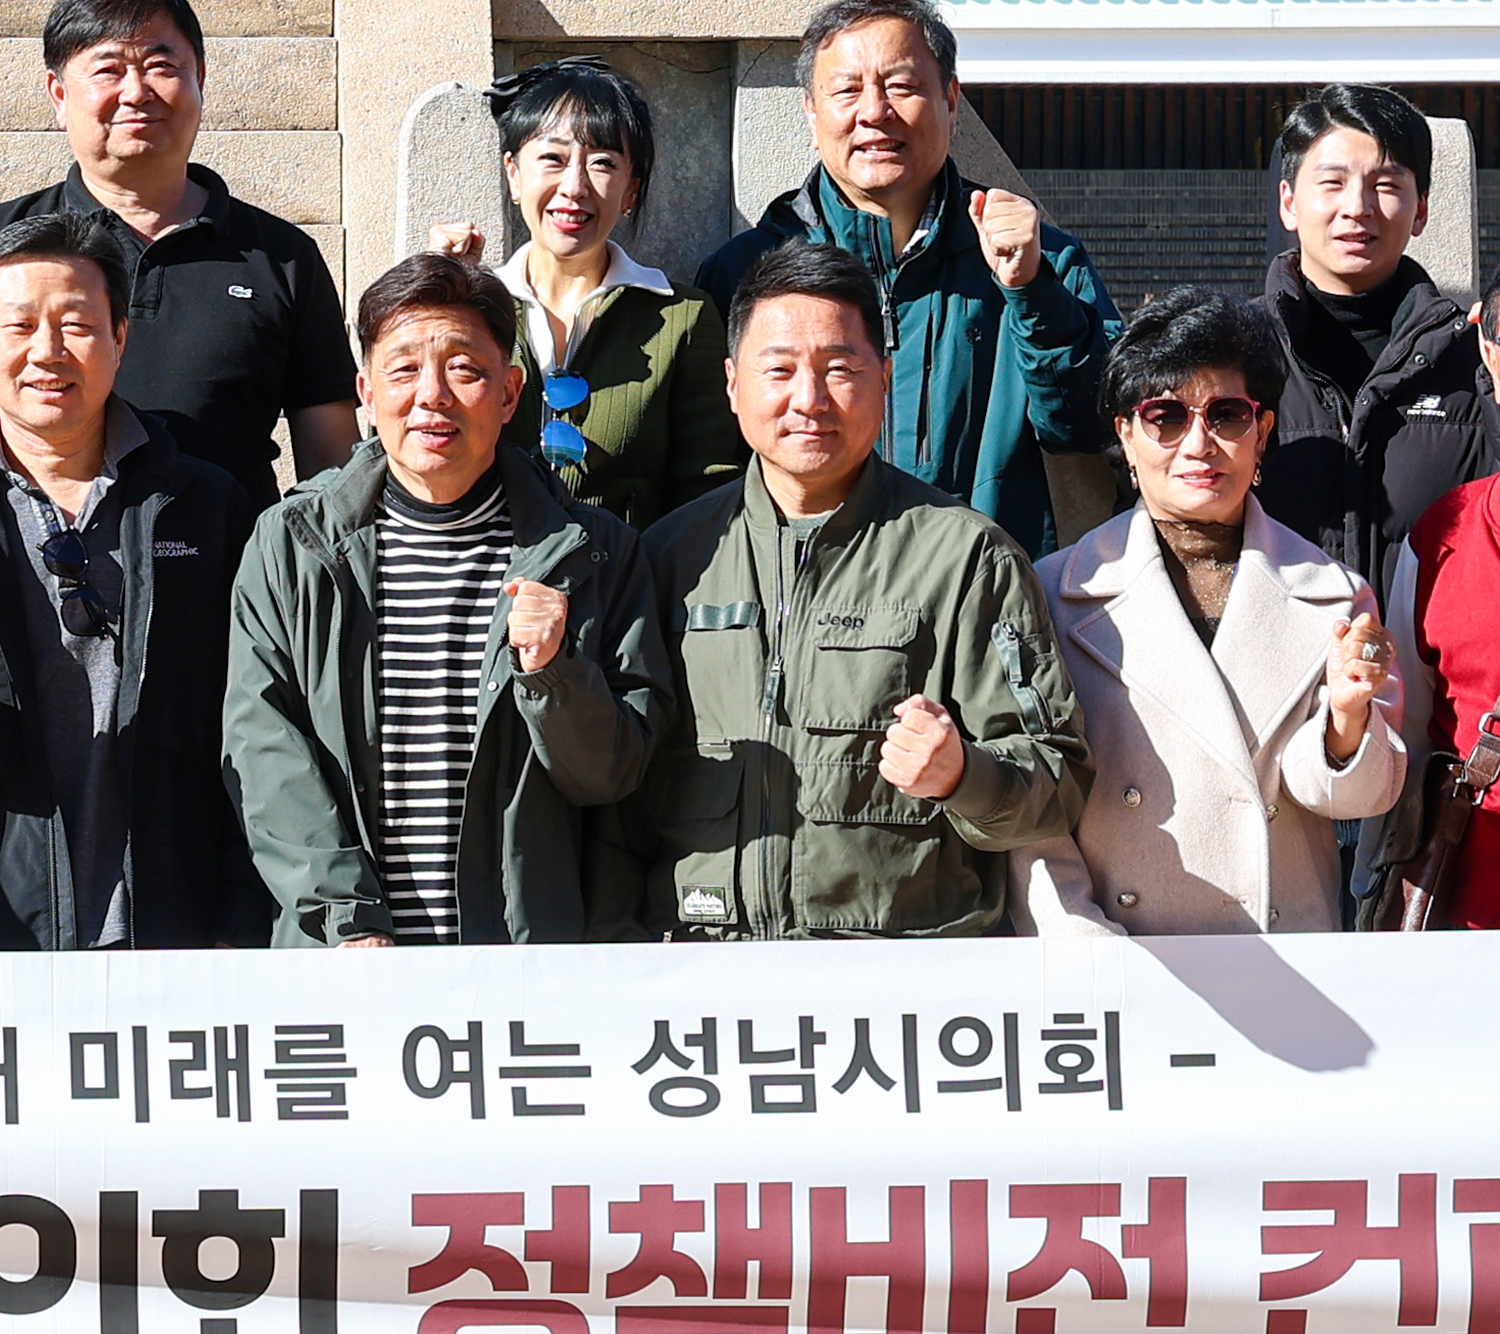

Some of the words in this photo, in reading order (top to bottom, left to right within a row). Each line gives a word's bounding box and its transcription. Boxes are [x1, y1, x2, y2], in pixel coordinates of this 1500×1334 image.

[817, 612, 865, 631] Jeep
[69, 1024, 359, 1124] 미래를
[402, 1020, 593, 1120] 여는
[632, 1011, 1124, 1119] 성남시의회
